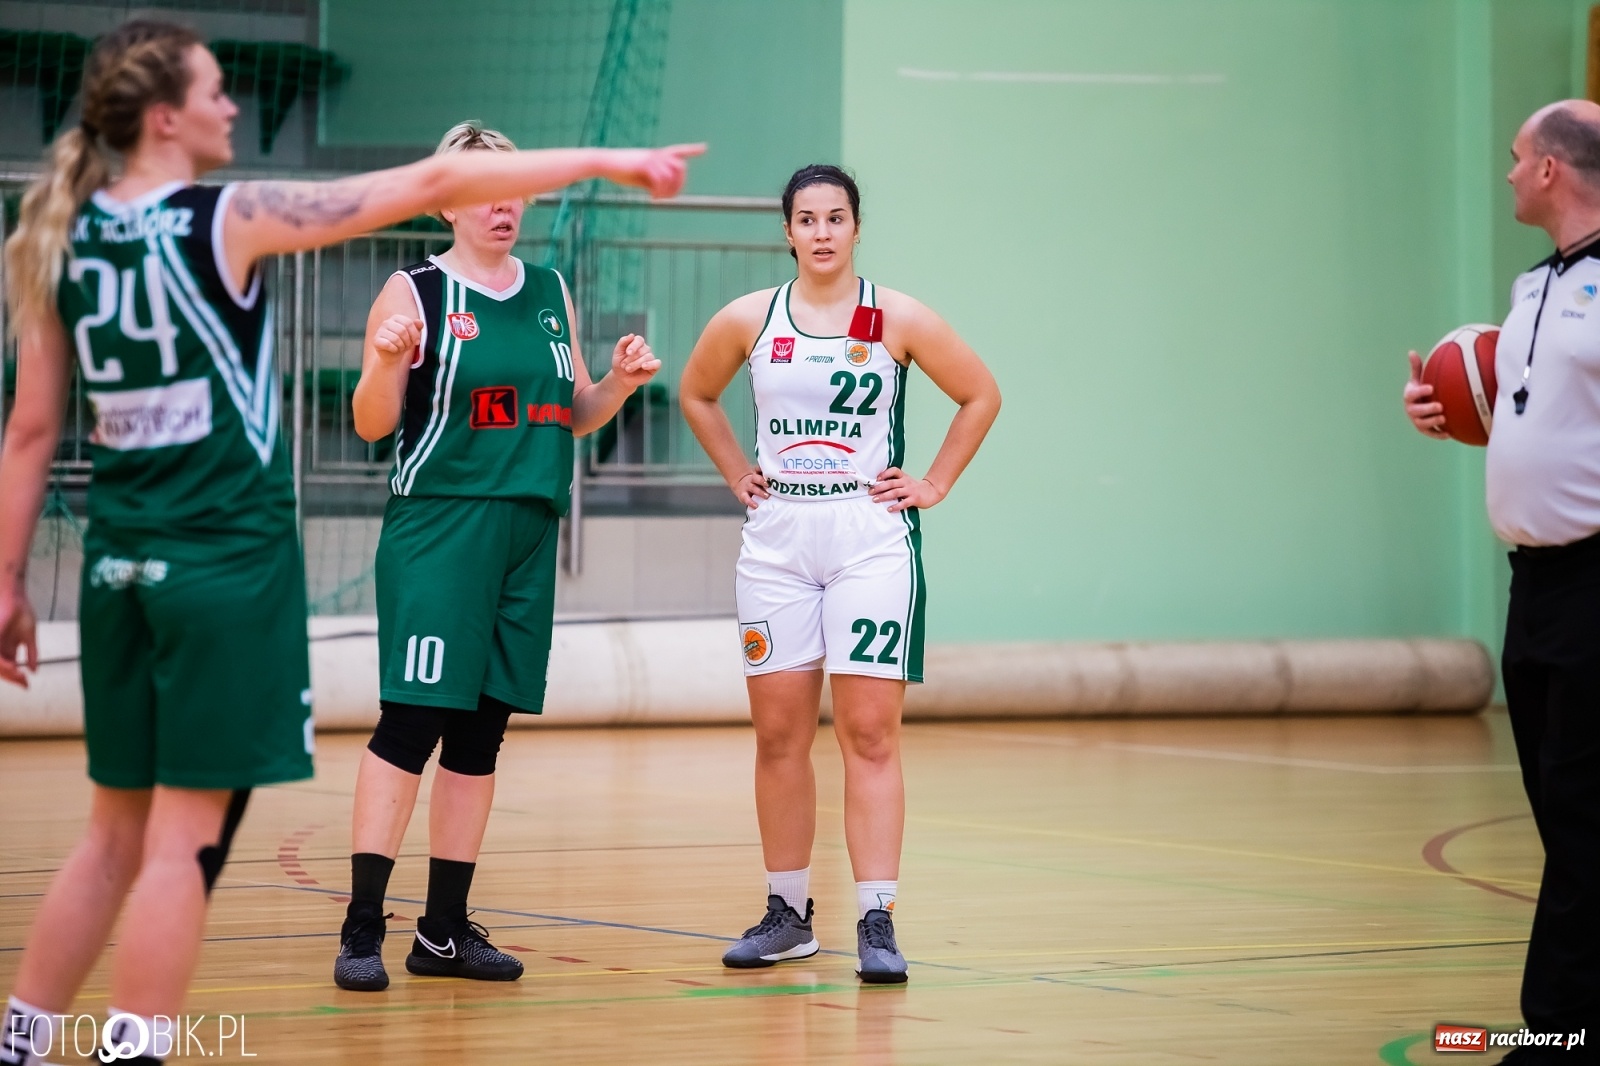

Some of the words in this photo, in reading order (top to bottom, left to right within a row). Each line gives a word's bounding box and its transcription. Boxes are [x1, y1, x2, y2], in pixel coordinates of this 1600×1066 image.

[68, 254, 180, 383] 24
[550, 341, 575, 382] 10
[808, 355, 835, 364] PROTON
[474, 391, 514, 424] K
[828, 370, 883, 416] 22
[769, 418, 862, 438] OLIMPIA
[404, 634, 445, 684] 10
[849, 618, 901, 665] 22
